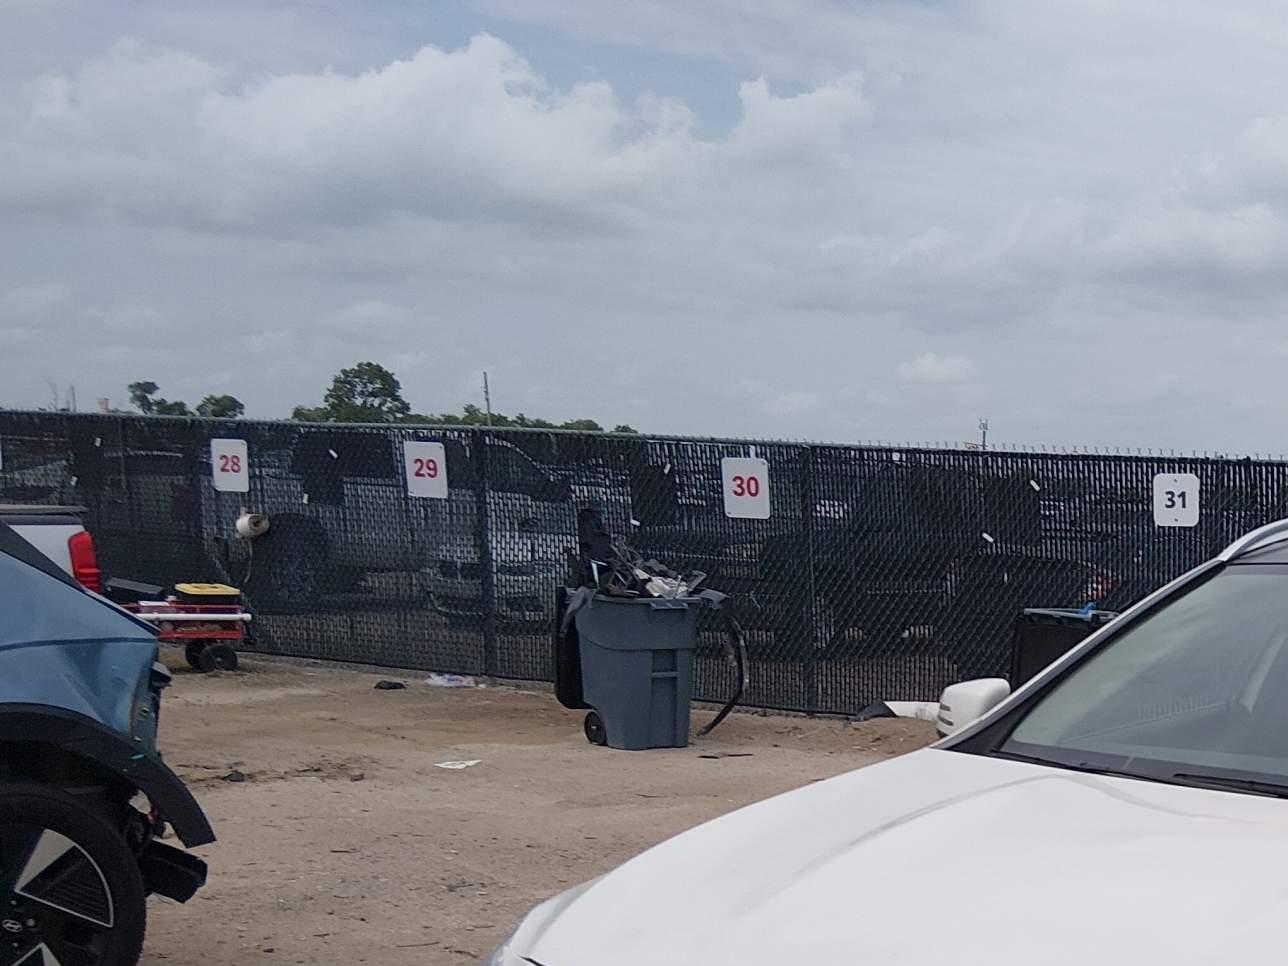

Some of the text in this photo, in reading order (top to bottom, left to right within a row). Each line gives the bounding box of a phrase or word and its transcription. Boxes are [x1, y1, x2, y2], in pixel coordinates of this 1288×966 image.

[220, 454, 241, 473] 28
[414, 458, 437, 478] 29
[732, 475, 759, 497] 30
[1164, 490, 1186, 509] 31
